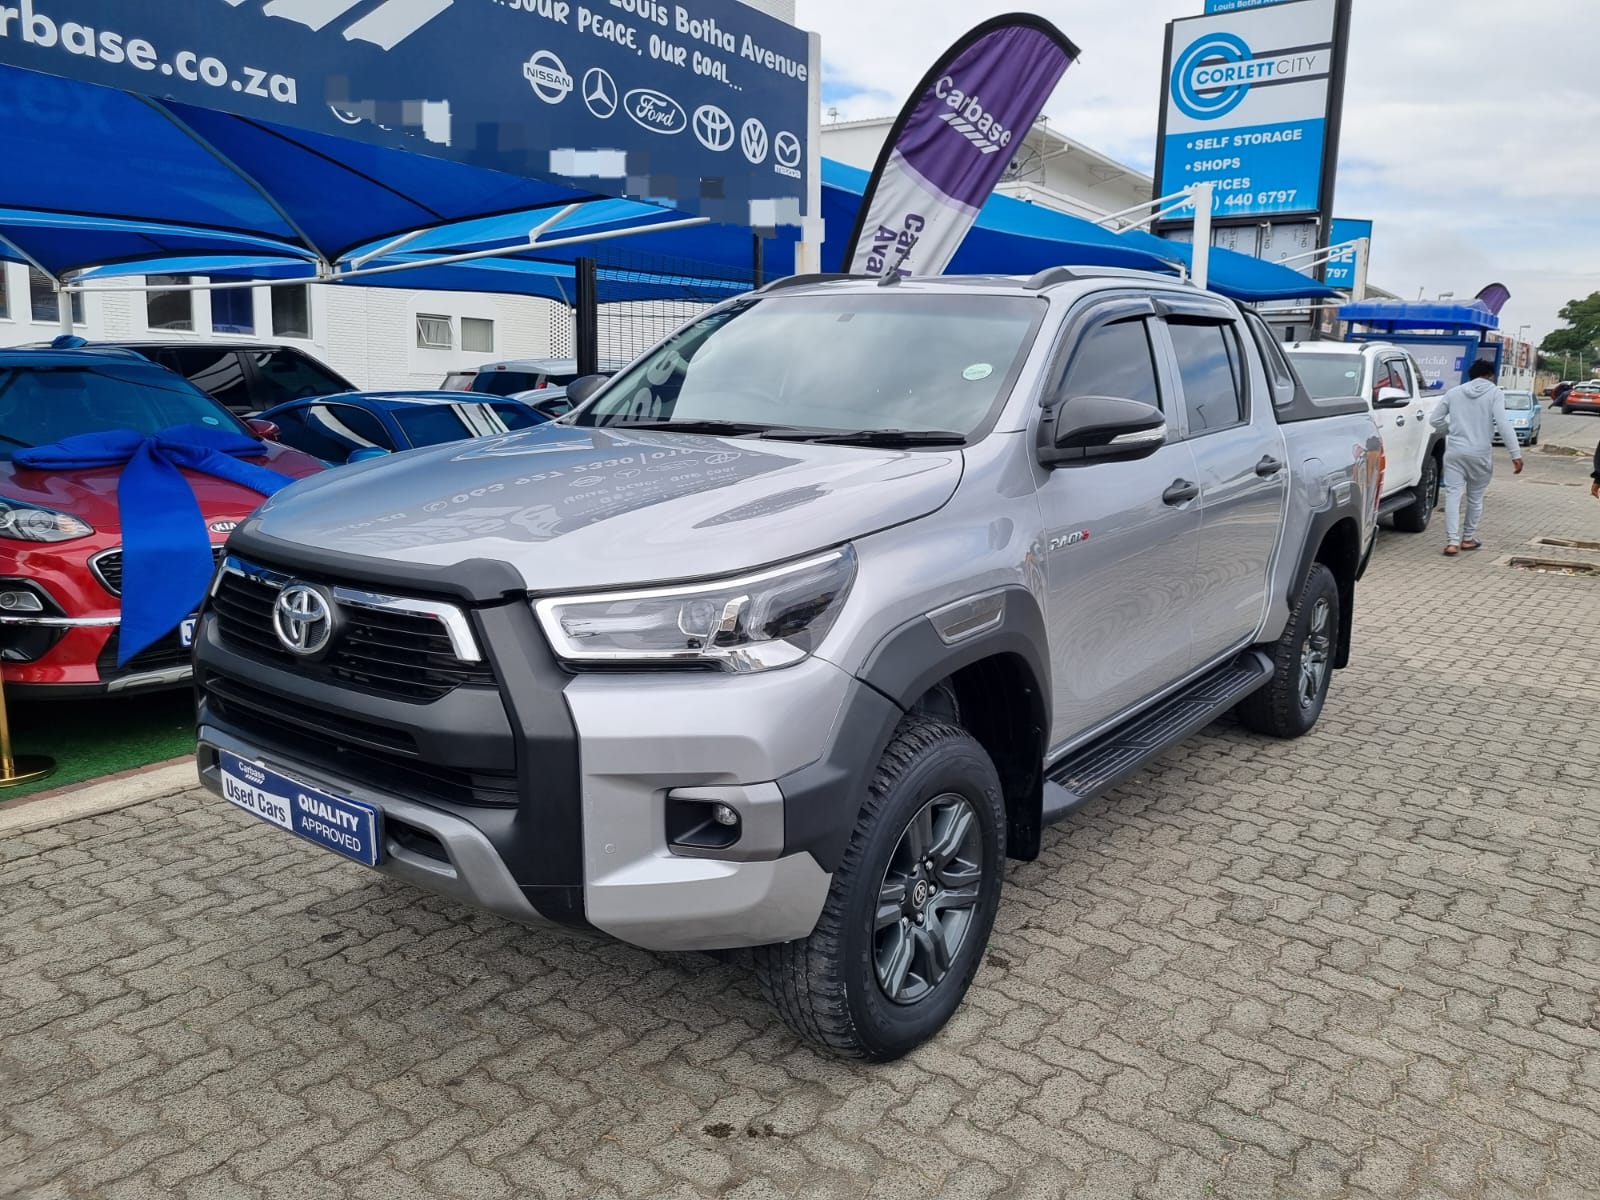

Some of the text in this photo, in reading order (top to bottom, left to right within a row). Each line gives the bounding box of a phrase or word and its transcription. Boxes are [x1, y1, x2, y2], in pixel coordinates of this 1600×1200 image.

[609, 0, 807, 81] ouis Botha Avenue
[650, 34, 687, 67] OUR
[526, 66, 570, 88] NISSAN
[635, 94, 676, 126] Ford
[935, 76, 1011, 147] Carbase
[1195, 128, 1303, 151] SELF STORAGE
[1193, 157, 1240, 172] SHOPS
[1223, 193, 1253, 206] 440
[1257, 189, 1297, 205] 6797
[866, 225, 898, 274] Ava
[214, 522, 238, 531] KIA
[226, 777, 286, 822] Used Cars
[298, 794, 359, 832] QUALITY
[302, 816, 361, 852] APPROVED
